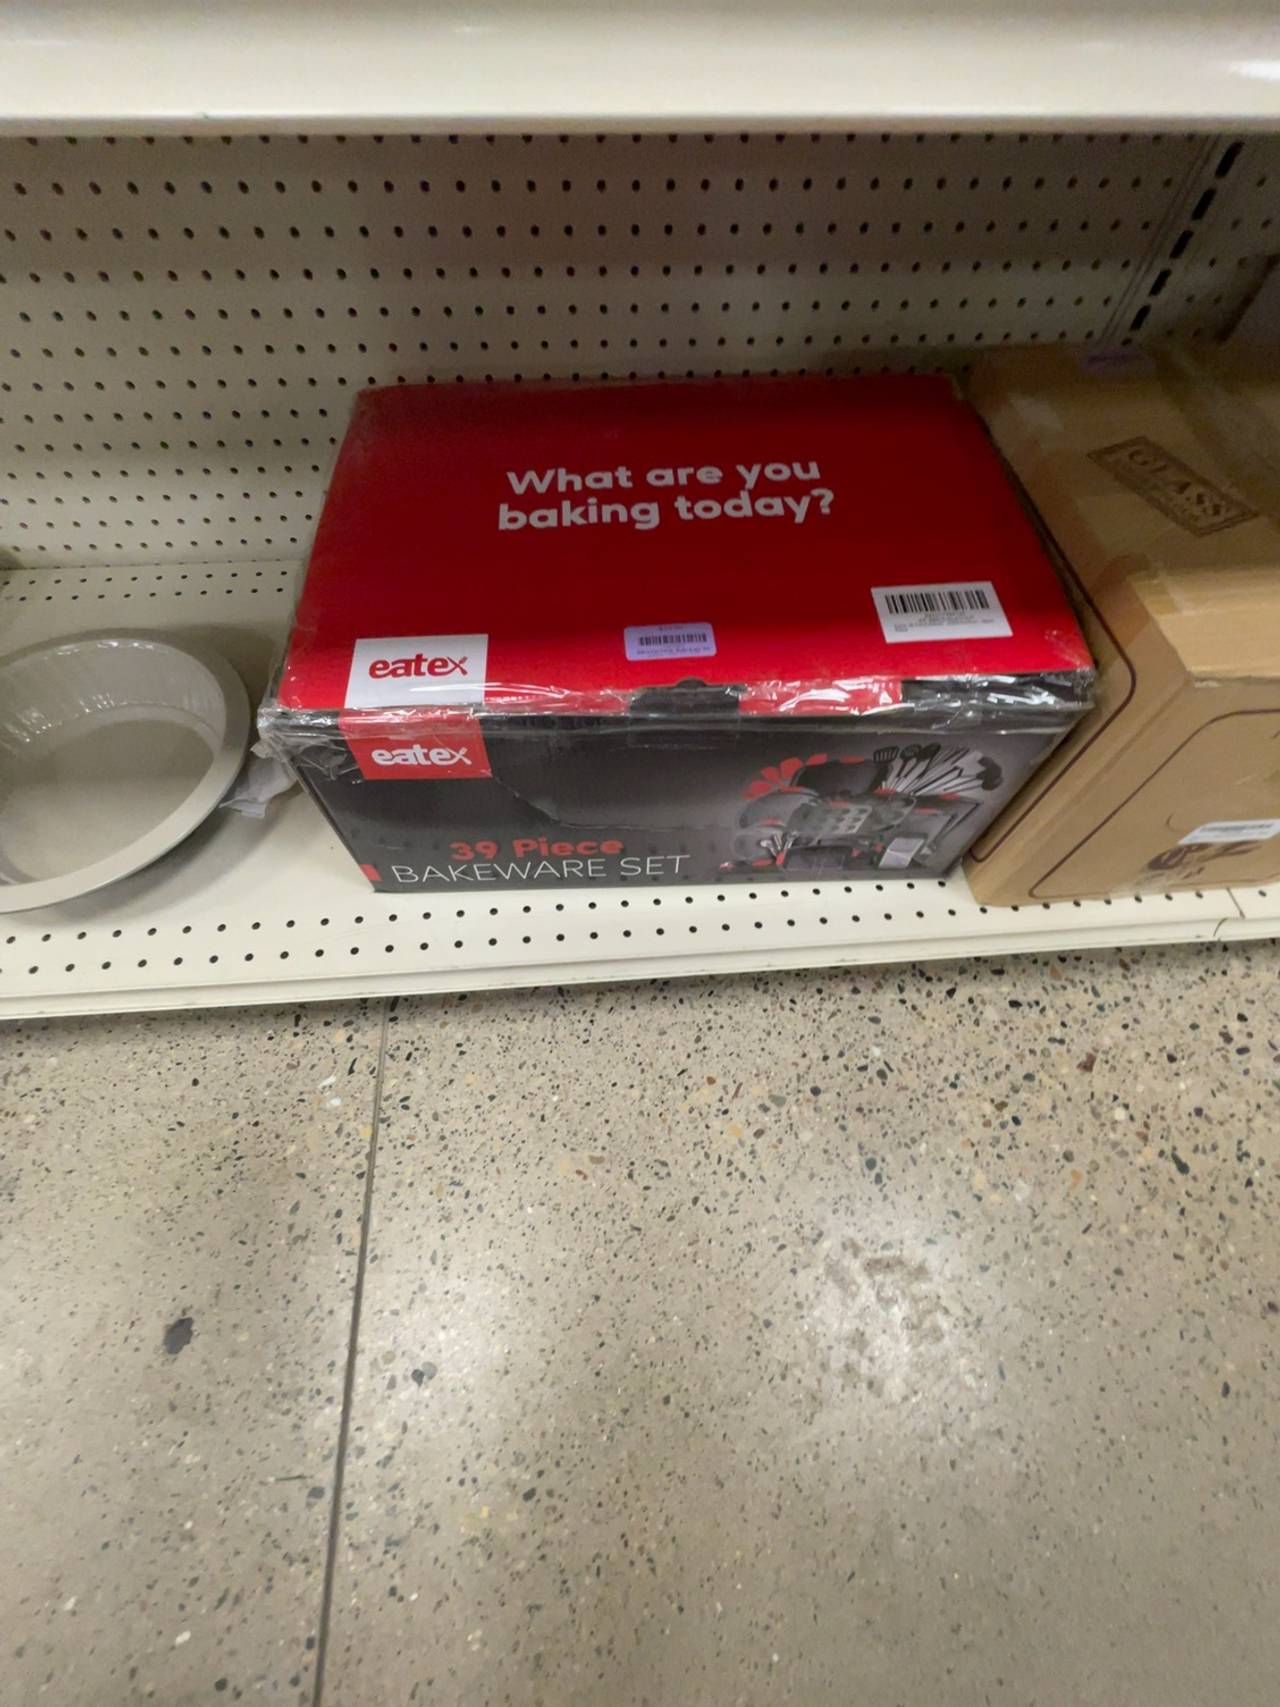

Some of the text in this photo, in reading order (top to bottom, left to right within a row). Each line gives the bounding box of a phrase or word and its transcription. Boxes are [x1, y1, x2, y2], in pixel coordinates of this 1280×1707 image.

[507, 460, 821, 496] What are you
[498, 487, 835, 530] baking today?
[368, 652, 468, 680] eatex
[371, 743, 473, 767] eatex
[449, 836, 625, 862] 39 Piece
[391, 854, 691, 884] BAKEWARE SET
